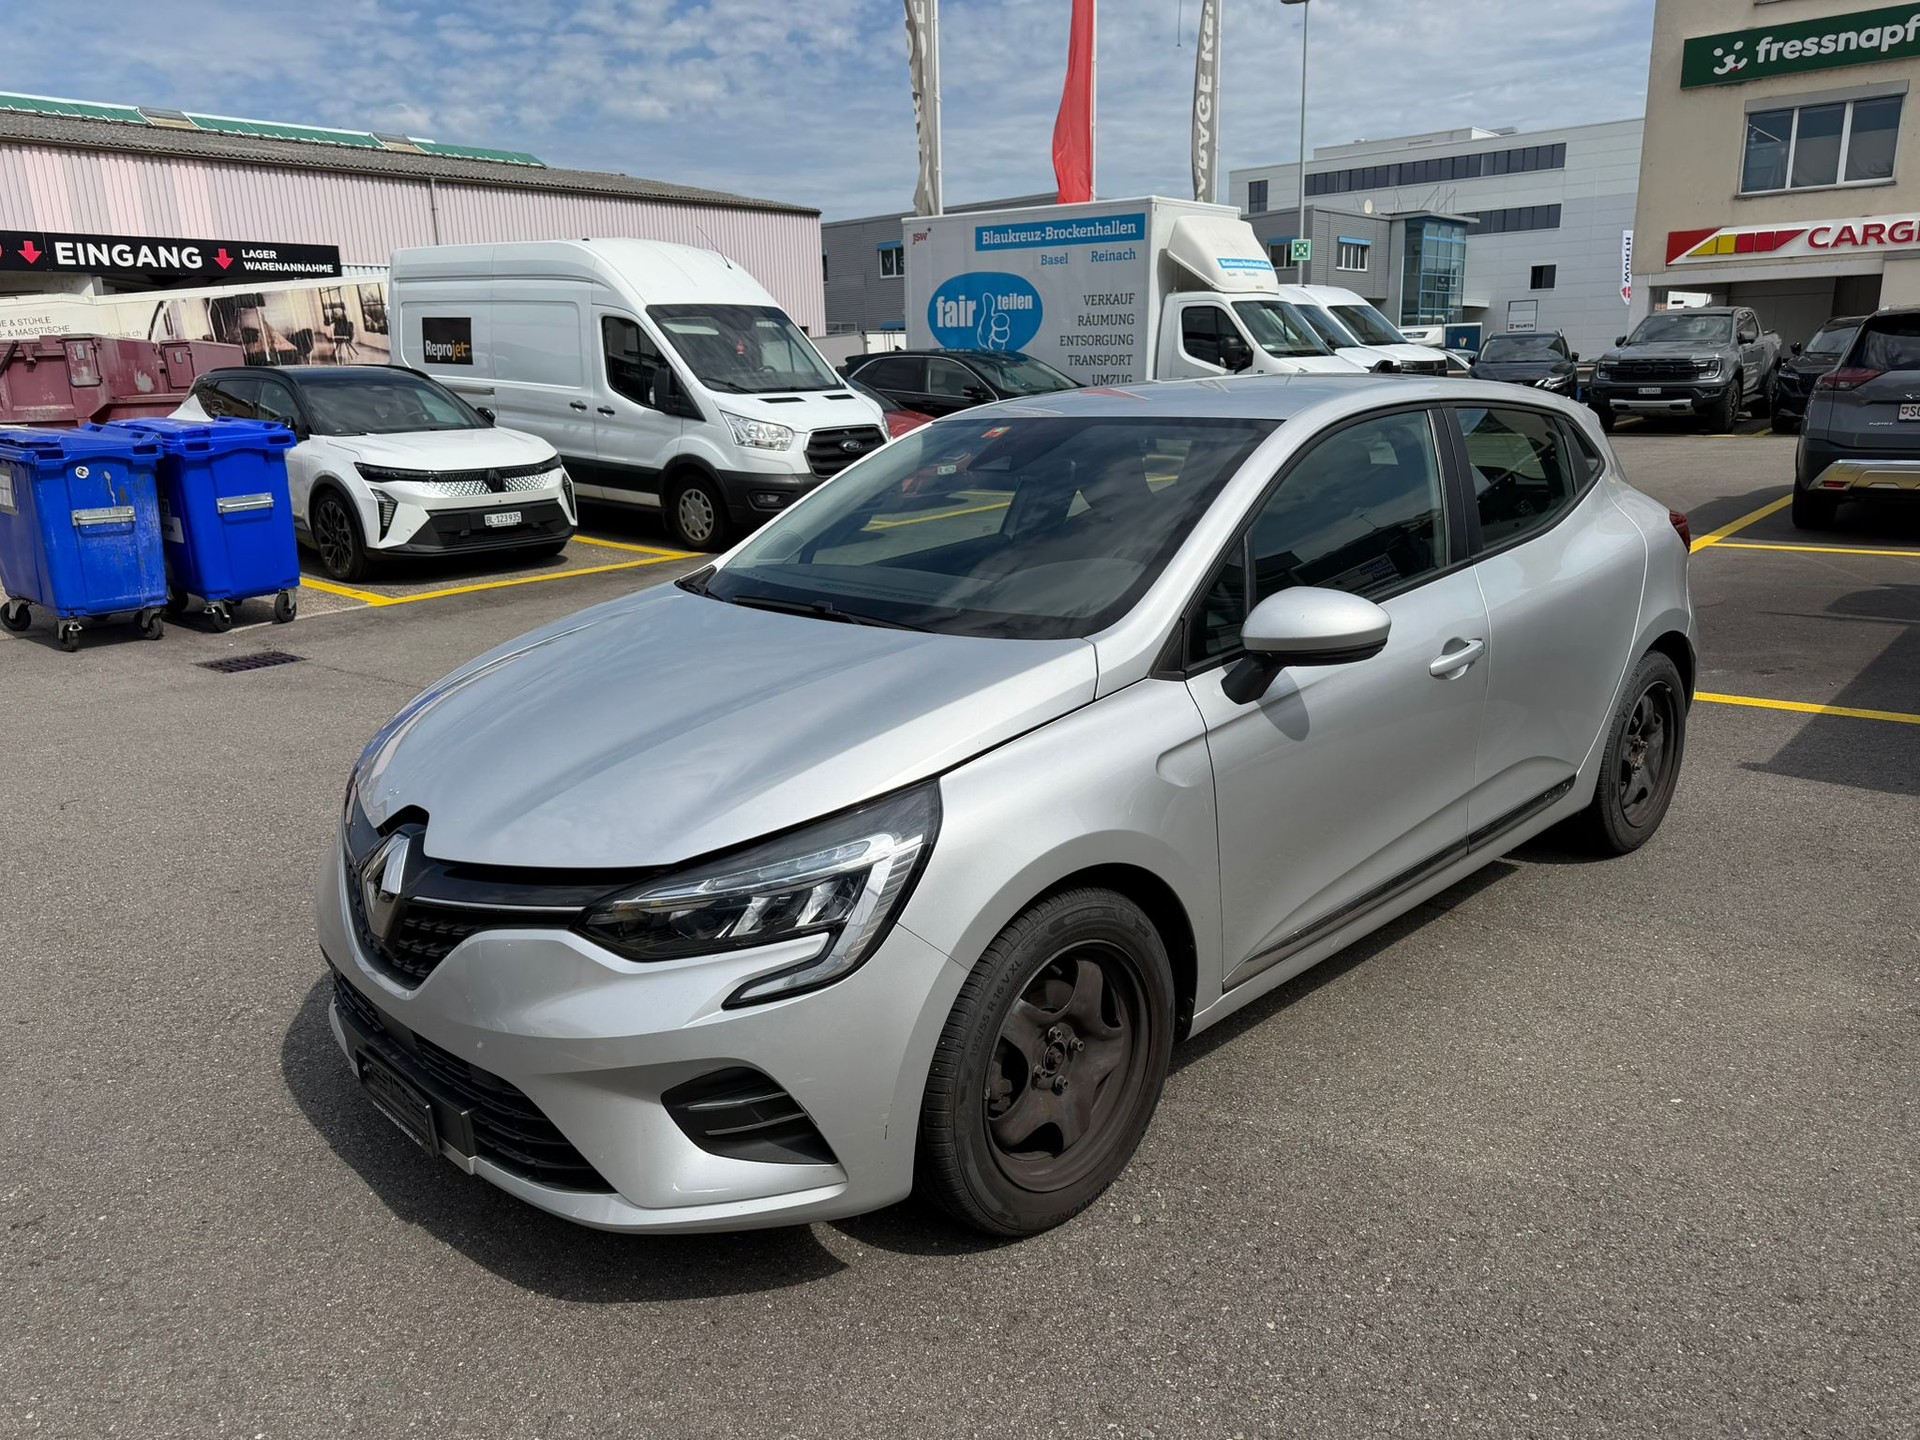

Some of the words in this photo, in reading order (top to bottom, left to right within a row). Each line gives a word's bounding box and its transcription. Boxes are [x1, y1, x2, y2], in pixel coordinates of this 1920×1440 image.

[1756, 13, 1920, 63] fressnapf
[982, 221, 1136, 245] Blaukreuz-Brockenhallen
[1807, 220, 1920, 249] CARG
[54, 241, 203, 269] EINGANG
[241, 249, 277, 259] LAGER
[1040, 253, 1068, 265] Basel
[1091, 248, 1136, 262] Reinach
[243, 261, 334, 273] WARENANNAHME
[1083, 293, 1135, 306] VERKAUF
[936, 295, 977, 328] fair
[997, 293, 1033, 310] teilen
[17, 316, 51, 326] STÜHLE
[1077, 312, 1135, 326] RÄUMUNG
[15, 325, 71, 336] MASSTISCHE
[1060, 334, 1134, 347] ENTSORGUNG
[425, 340, 470, 361] Reprojet
[1067, 354, 1133, 366] TRANSPORT
